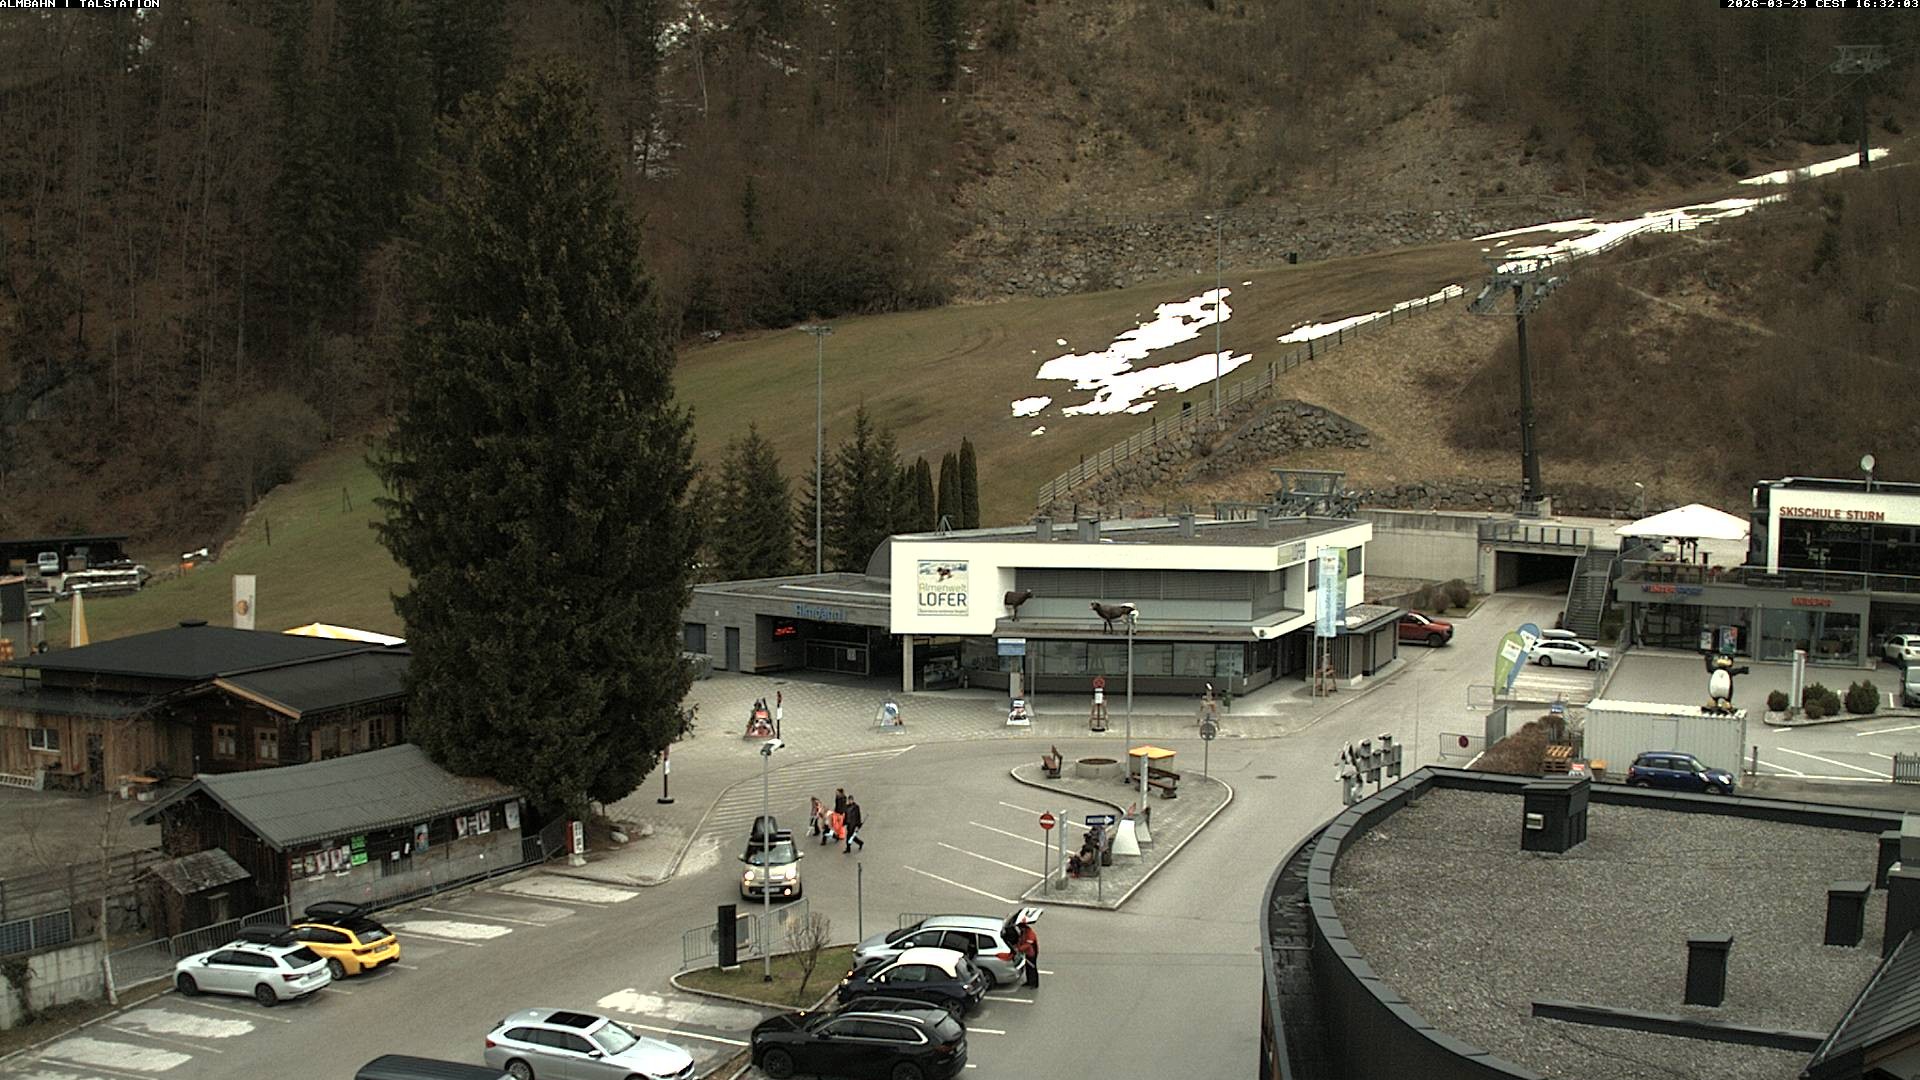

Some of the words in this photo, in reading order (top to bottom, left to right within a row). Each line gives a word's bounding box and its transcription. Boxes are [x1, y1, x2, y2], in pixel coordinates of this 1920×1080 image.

[1779, 506, 1841, 519] SKISCHULE
[1846, 510, 1885, 521] STURM
[919, 583, 967, 592] Almenwelt
[919, 592, 967, 606] LOFER
